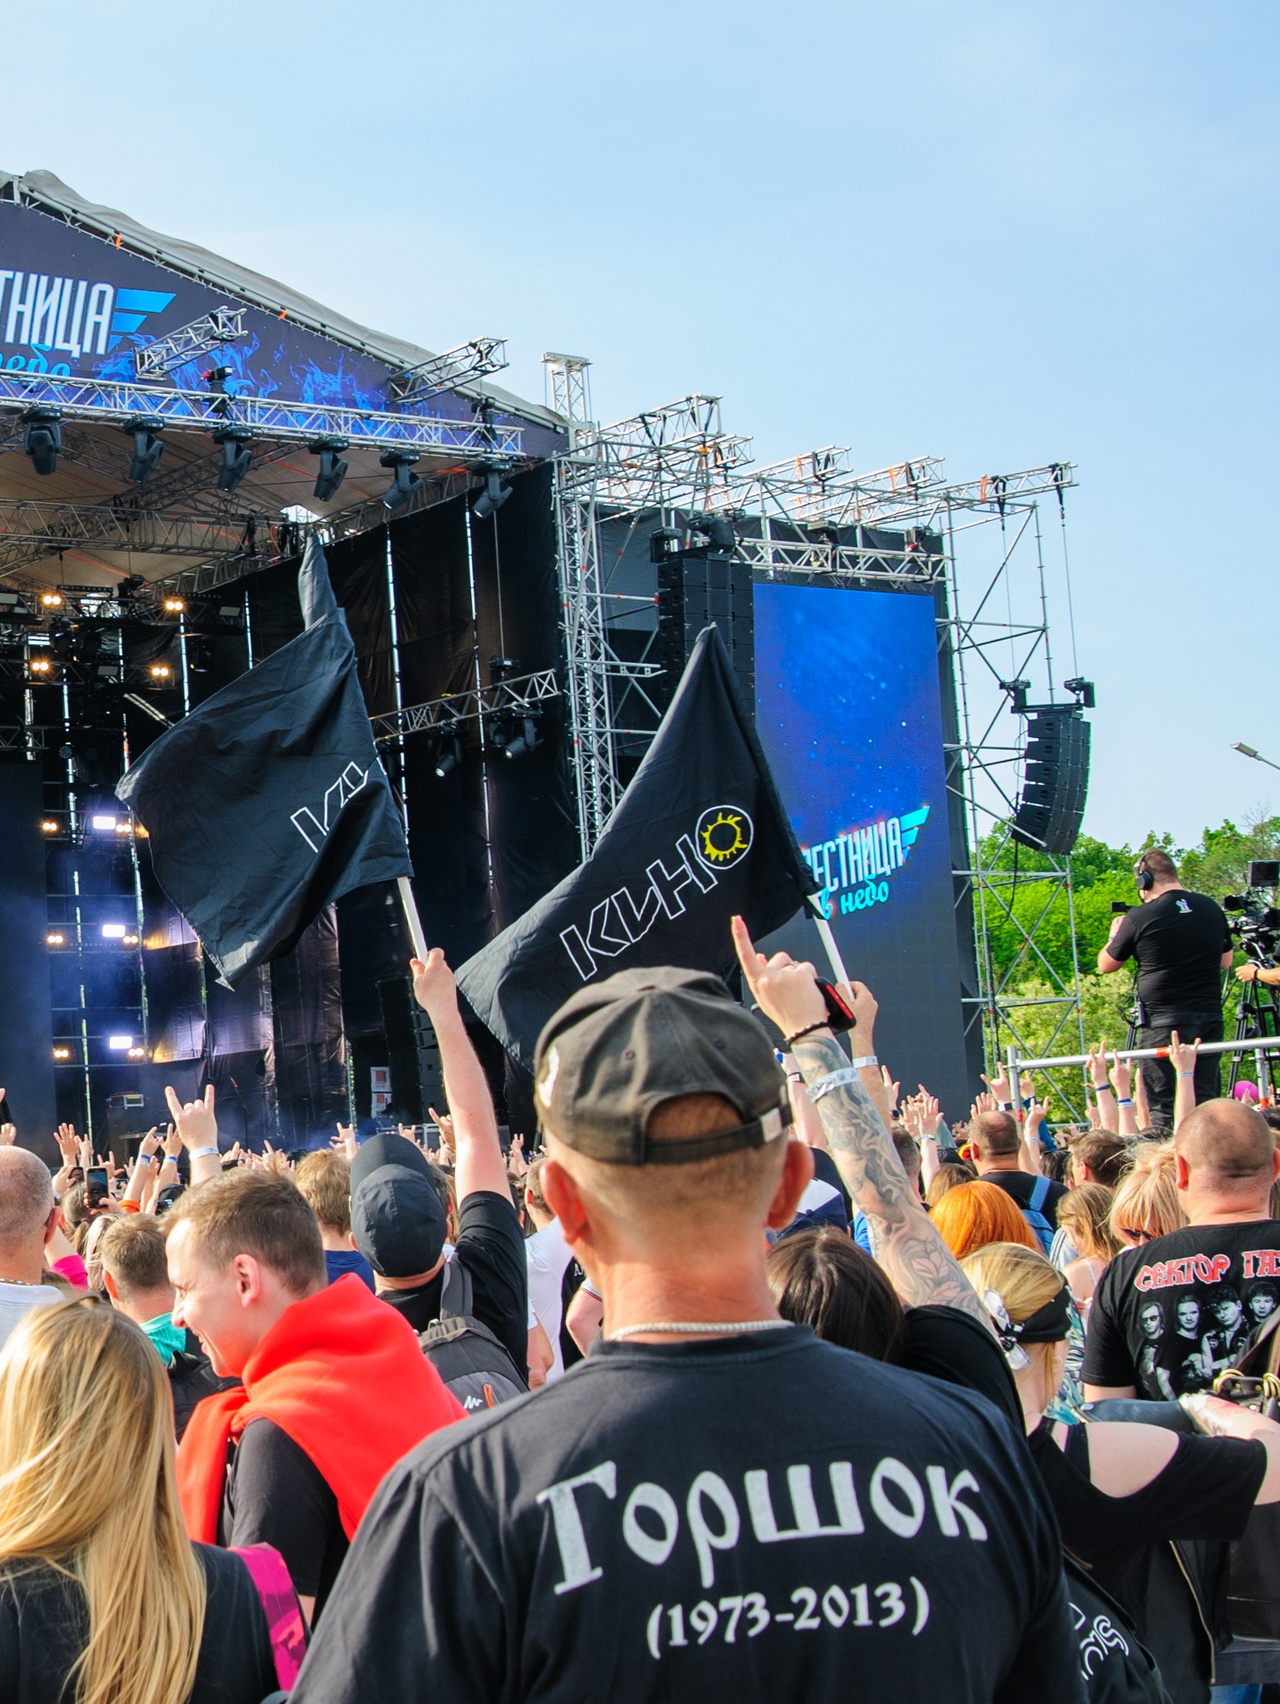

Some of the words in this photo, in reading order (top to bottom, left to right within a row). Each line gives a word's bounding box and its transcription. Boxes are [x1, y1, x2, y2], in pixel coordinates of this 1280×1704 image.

[559, 805, 754, 982] КИНО
[801, 817, 904, 897] ЕСТНИЦА
[841, 874, 889, 915] небо
[1134, 1253, 1231, 1292] СЕКТОР
[647, 1576, 930, 1660] (1973-2013)
